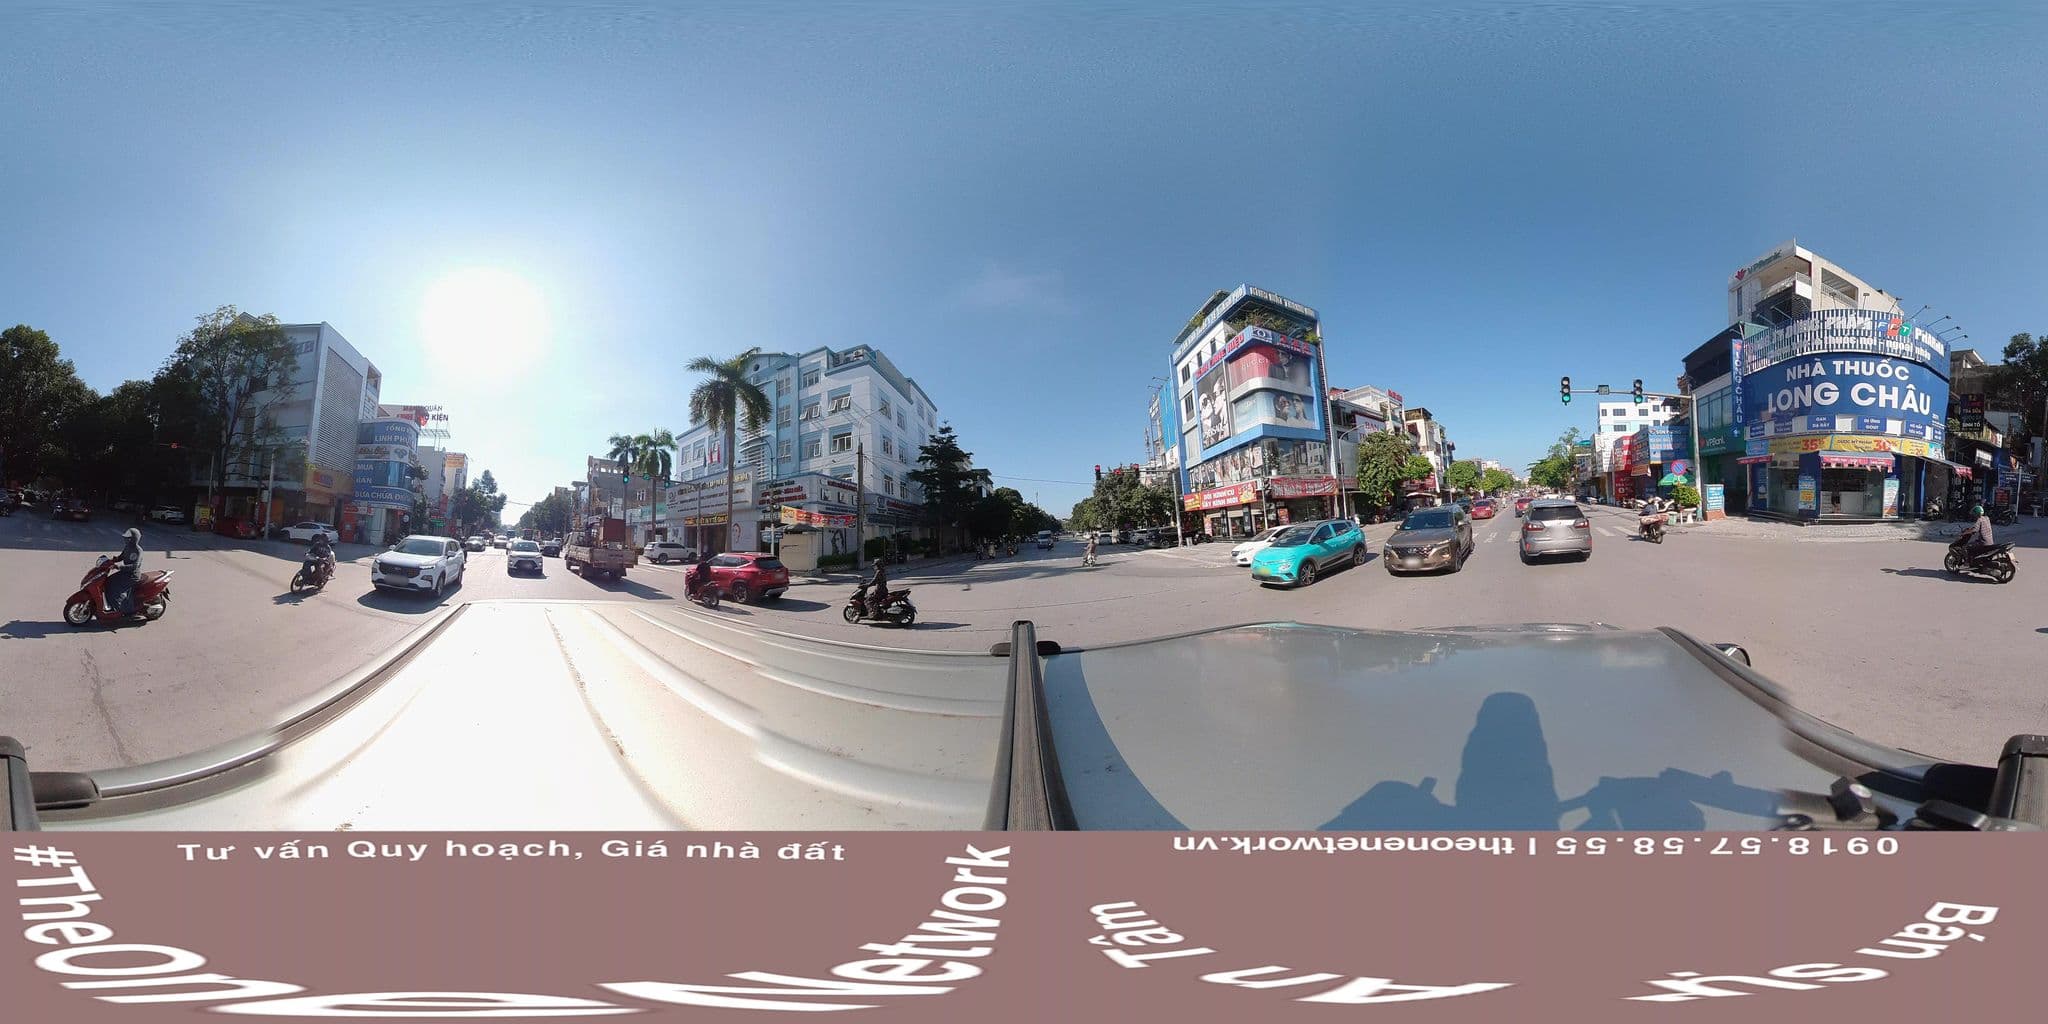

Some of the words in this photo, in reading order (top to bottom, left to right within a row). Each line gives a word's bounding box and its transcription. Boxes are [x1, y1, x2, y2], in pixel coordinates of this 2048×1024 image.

[1786, 357, 1826, 382] NHÀ
[1832, 356, 1910, 381] THUỐC
[1767, 382, 1840, 413] LONG
[1850, 382, 1931, 416] CHÂU
